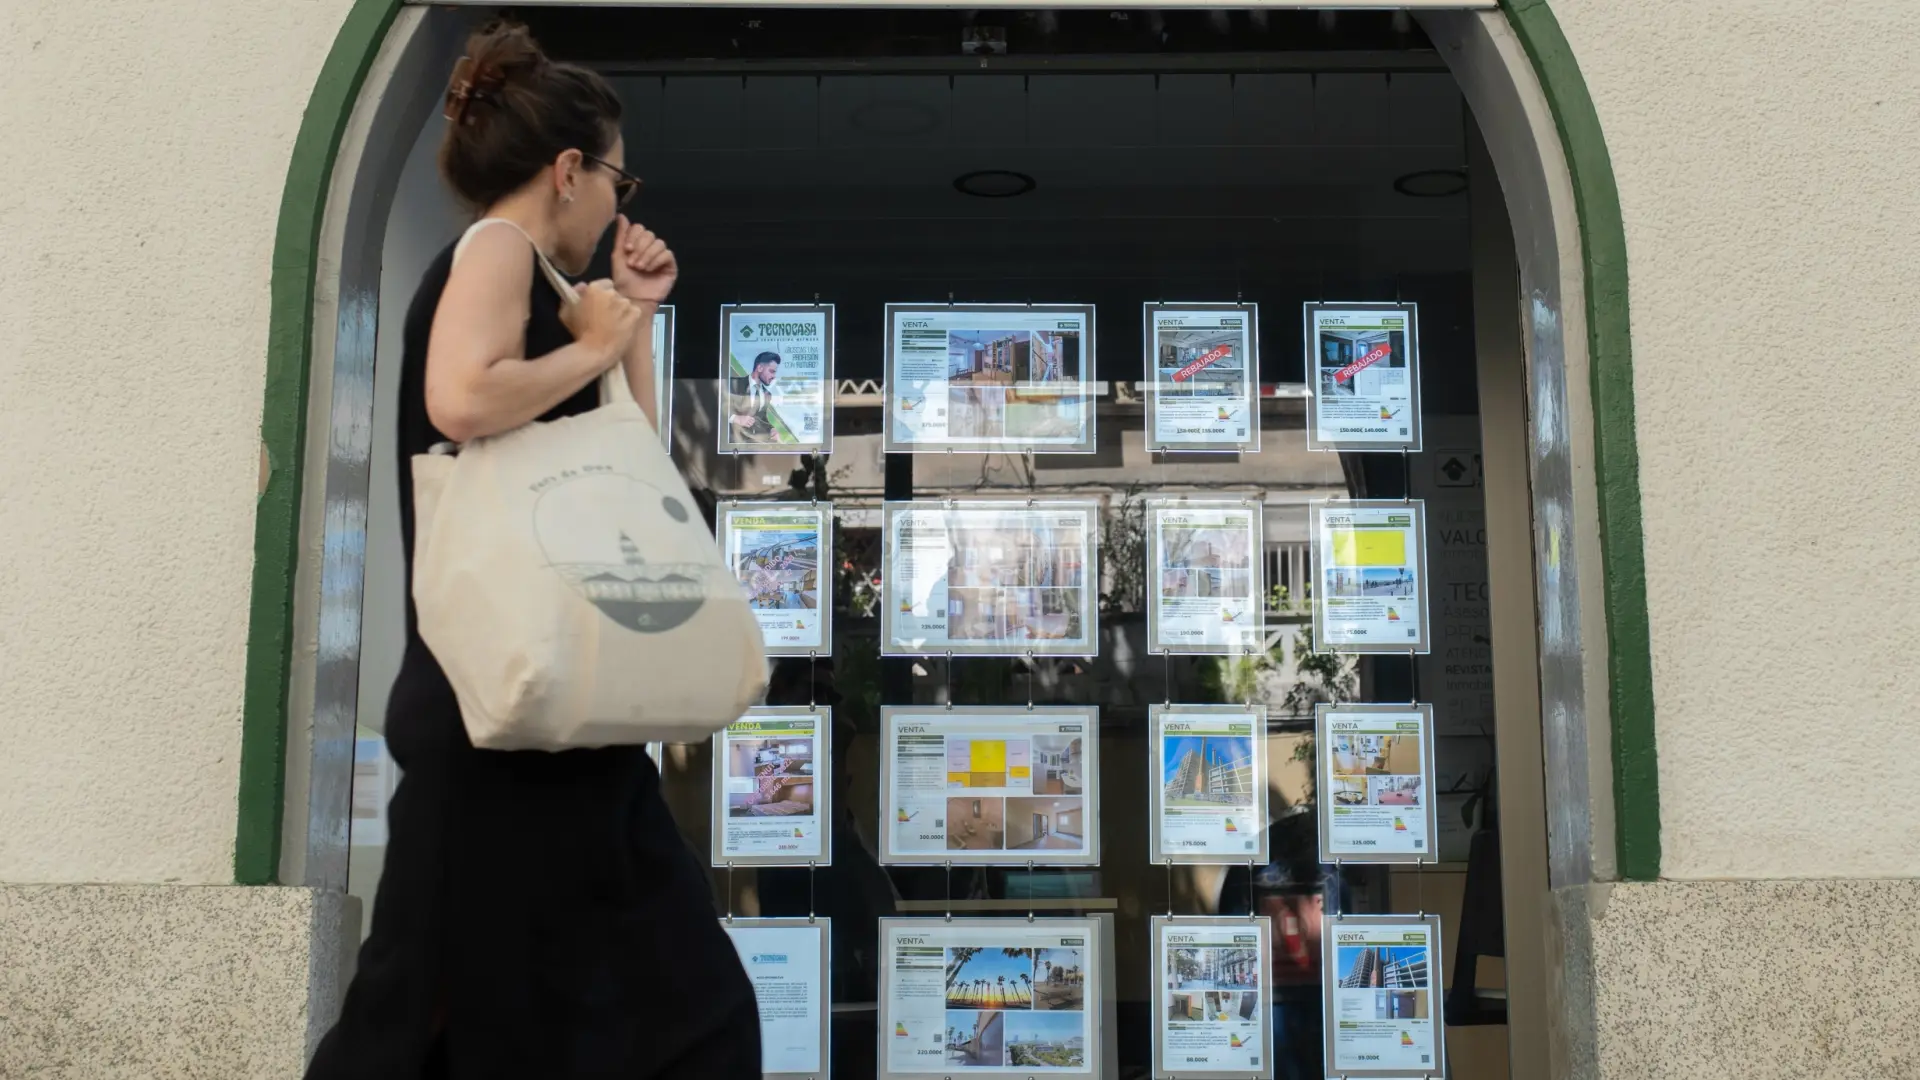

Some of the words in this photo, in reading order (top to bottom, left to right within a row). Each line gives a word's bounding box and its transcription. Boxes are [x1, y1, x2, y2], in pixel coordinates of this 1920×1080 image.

[758, 322, 817, 337] TECNOCASA
[1180, 350, 1221, 379] REBAJADO
[1342, 349, 1383, 378] REBAJADO
[733, 516, 766, 524] VENDA
[729, 722, 761, 730] VENDA
[1164, 723, 1190, 731] VENTA
[897, 937, 924, 945] VENTA
[1168, 935, 1194, 943] VENTA
